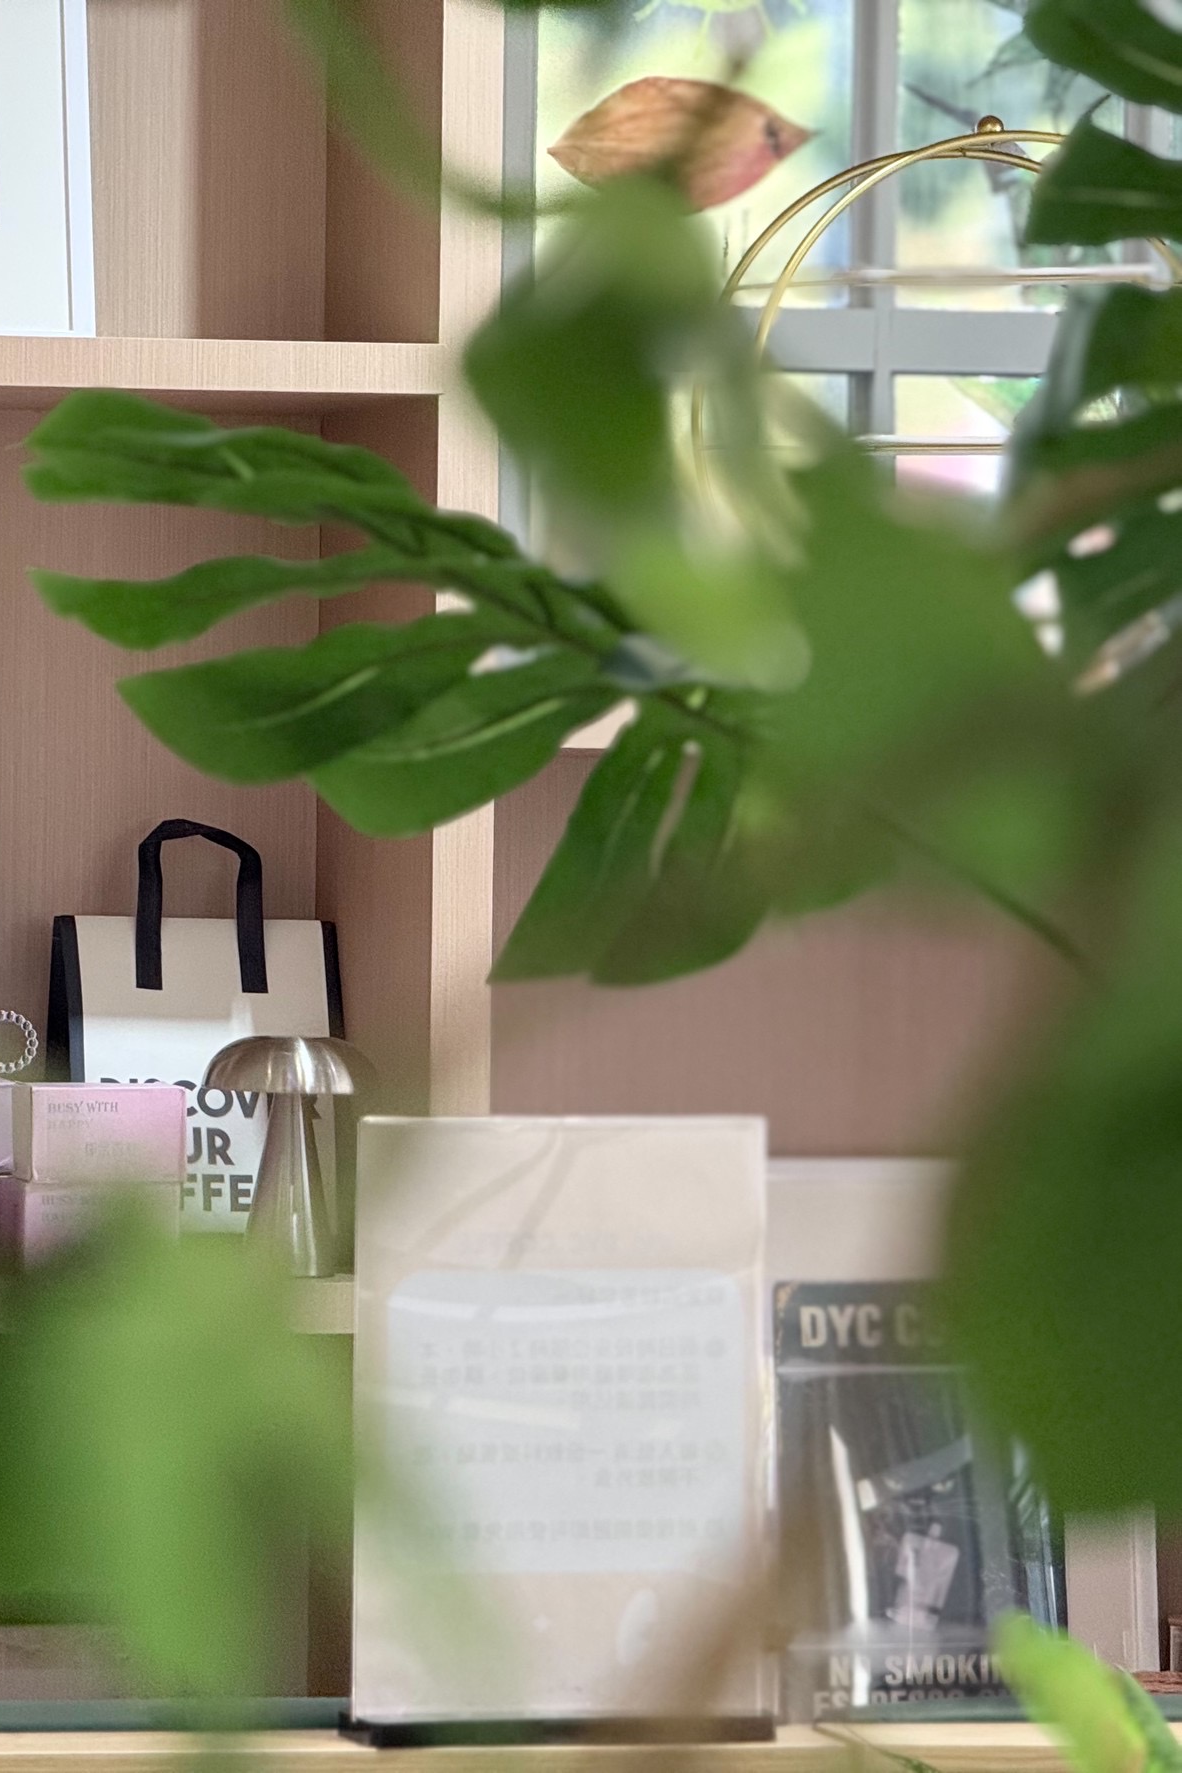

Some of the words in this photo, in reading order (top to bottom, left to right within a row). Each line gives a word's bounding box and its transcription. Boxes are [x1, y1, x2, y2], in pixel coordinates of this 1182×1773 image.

[48, 1101, 84, 1114] BUSY
[86, 1101, 119, 1113] WITH
[800, 1304, 882, 1348] DYC
[885, 1653, 1012, 1686] SMOKIN
